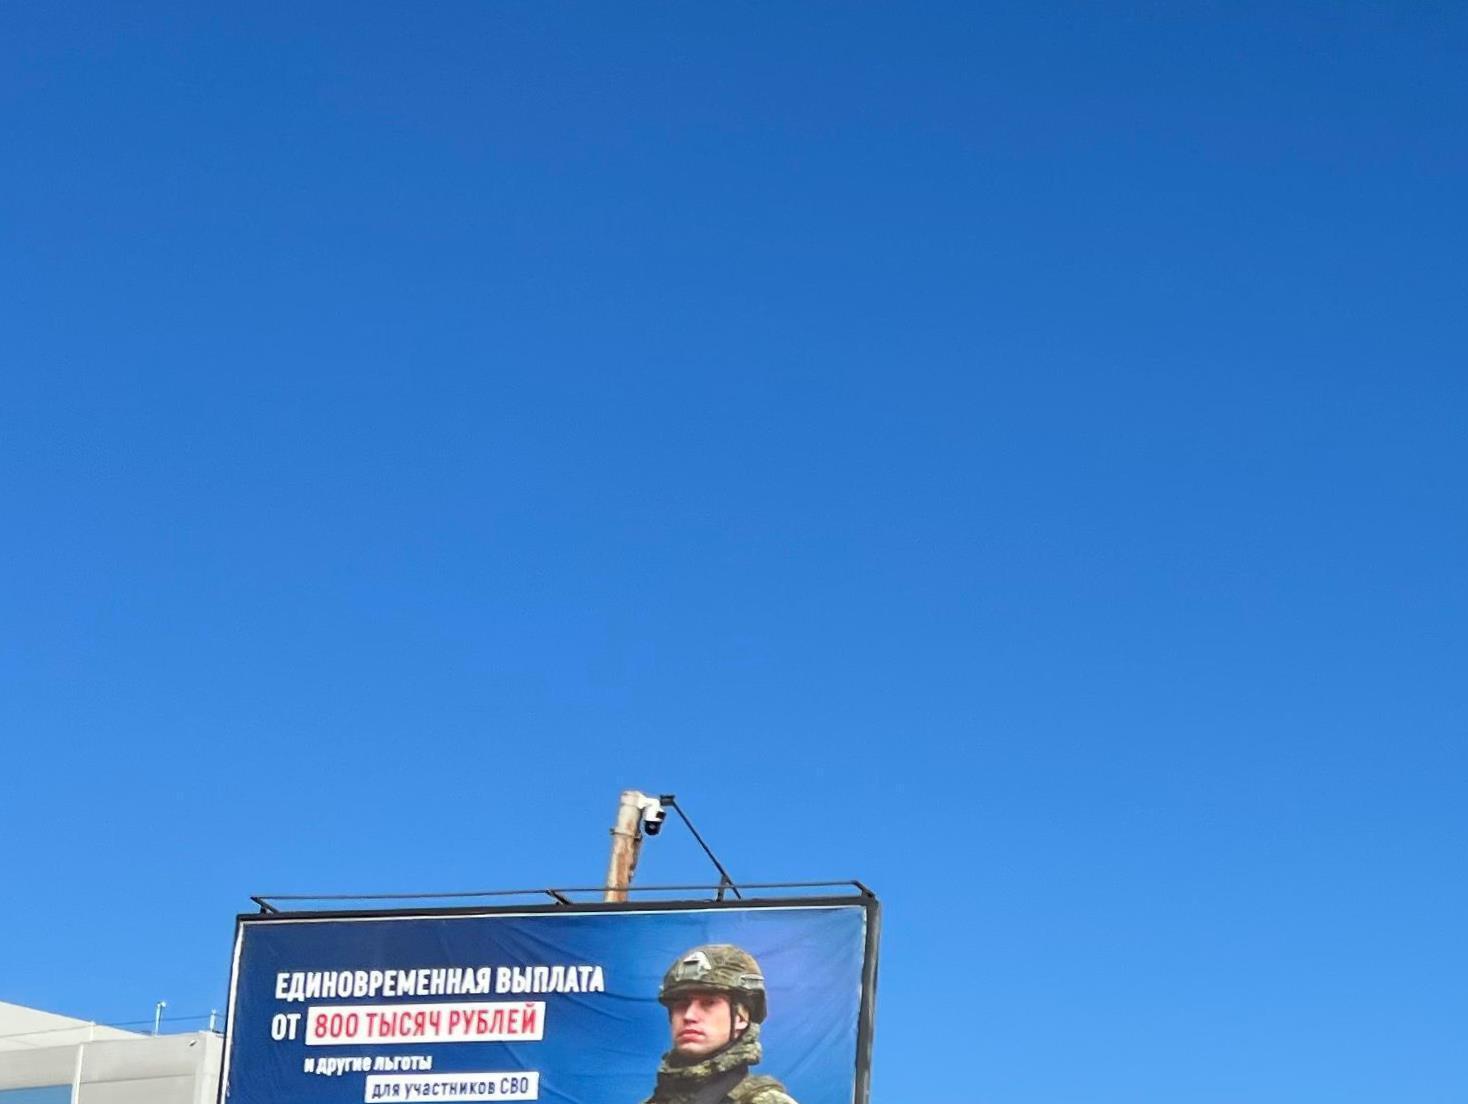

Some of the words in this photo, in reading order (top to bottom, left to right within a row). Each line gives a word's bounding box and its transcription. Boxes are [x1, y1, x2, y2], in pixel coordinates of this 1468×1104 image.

[275, 967, 491, 1002] ЕДИНОВРЕМЕННАЯ
[496, 966, 605, 994] ВЫПЛАТА
[271, 1013, 301, 1040] ОТ
[315, 1013, 359, 1038] 800
[366, 1010, 441, 1037] ТЫСЯЧ
[448, 1003, 537, 1036] РУБЛЕЙ
[304, 1058, 315, 1073] и
[316, 1057, 371, 1076] другие
[374, 1056, 433, 1072] льготы
[372, 1083, 401, 1099] для
[405, 1080, 496, 1099] участников
[500, 1077, 529, 1095] СВО
